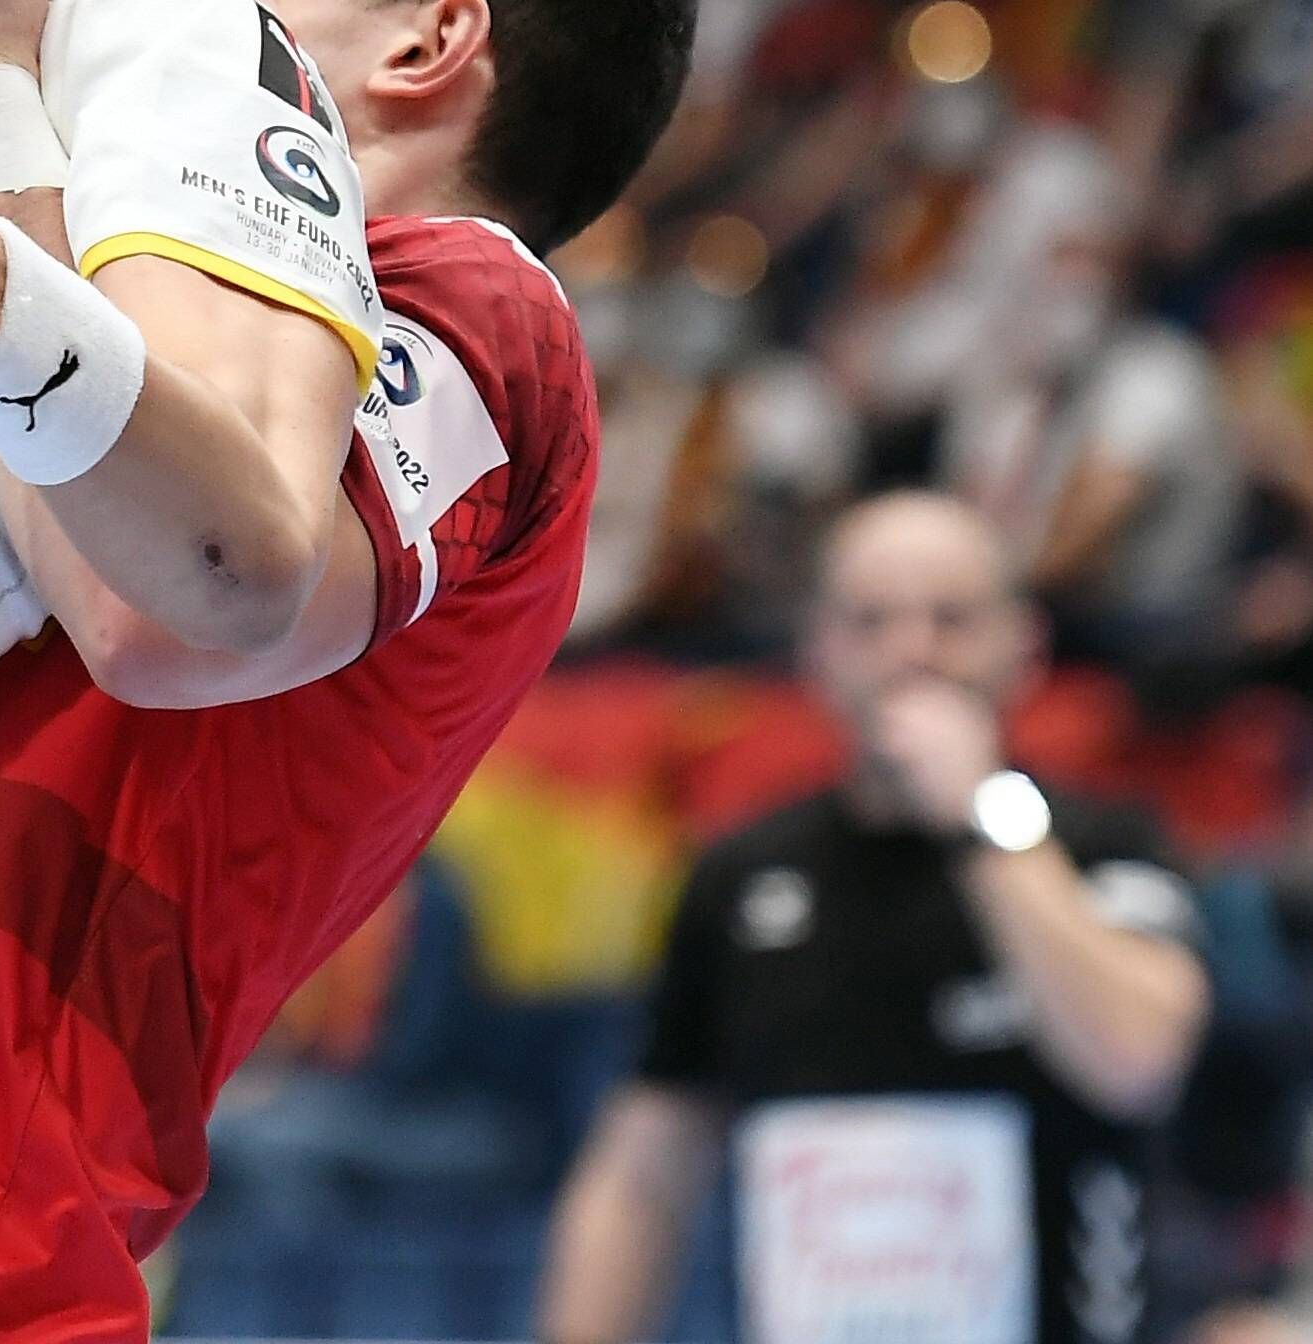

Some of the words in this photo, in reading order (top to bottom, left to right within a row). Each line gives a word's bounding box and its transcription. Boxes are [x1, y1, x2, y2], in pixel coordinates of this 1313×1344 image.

[180, 165, 247, 206] MEN'S
[253, 196, 293, 226] EHF
[296, 214, 342, 261] EURO
[344, 253, 375, 314] 2022
[236, 211, 289, 249] HUNGARY
[245, 232, 282, 258] 13-30
[285, 250, 335, 286] JANUARY
